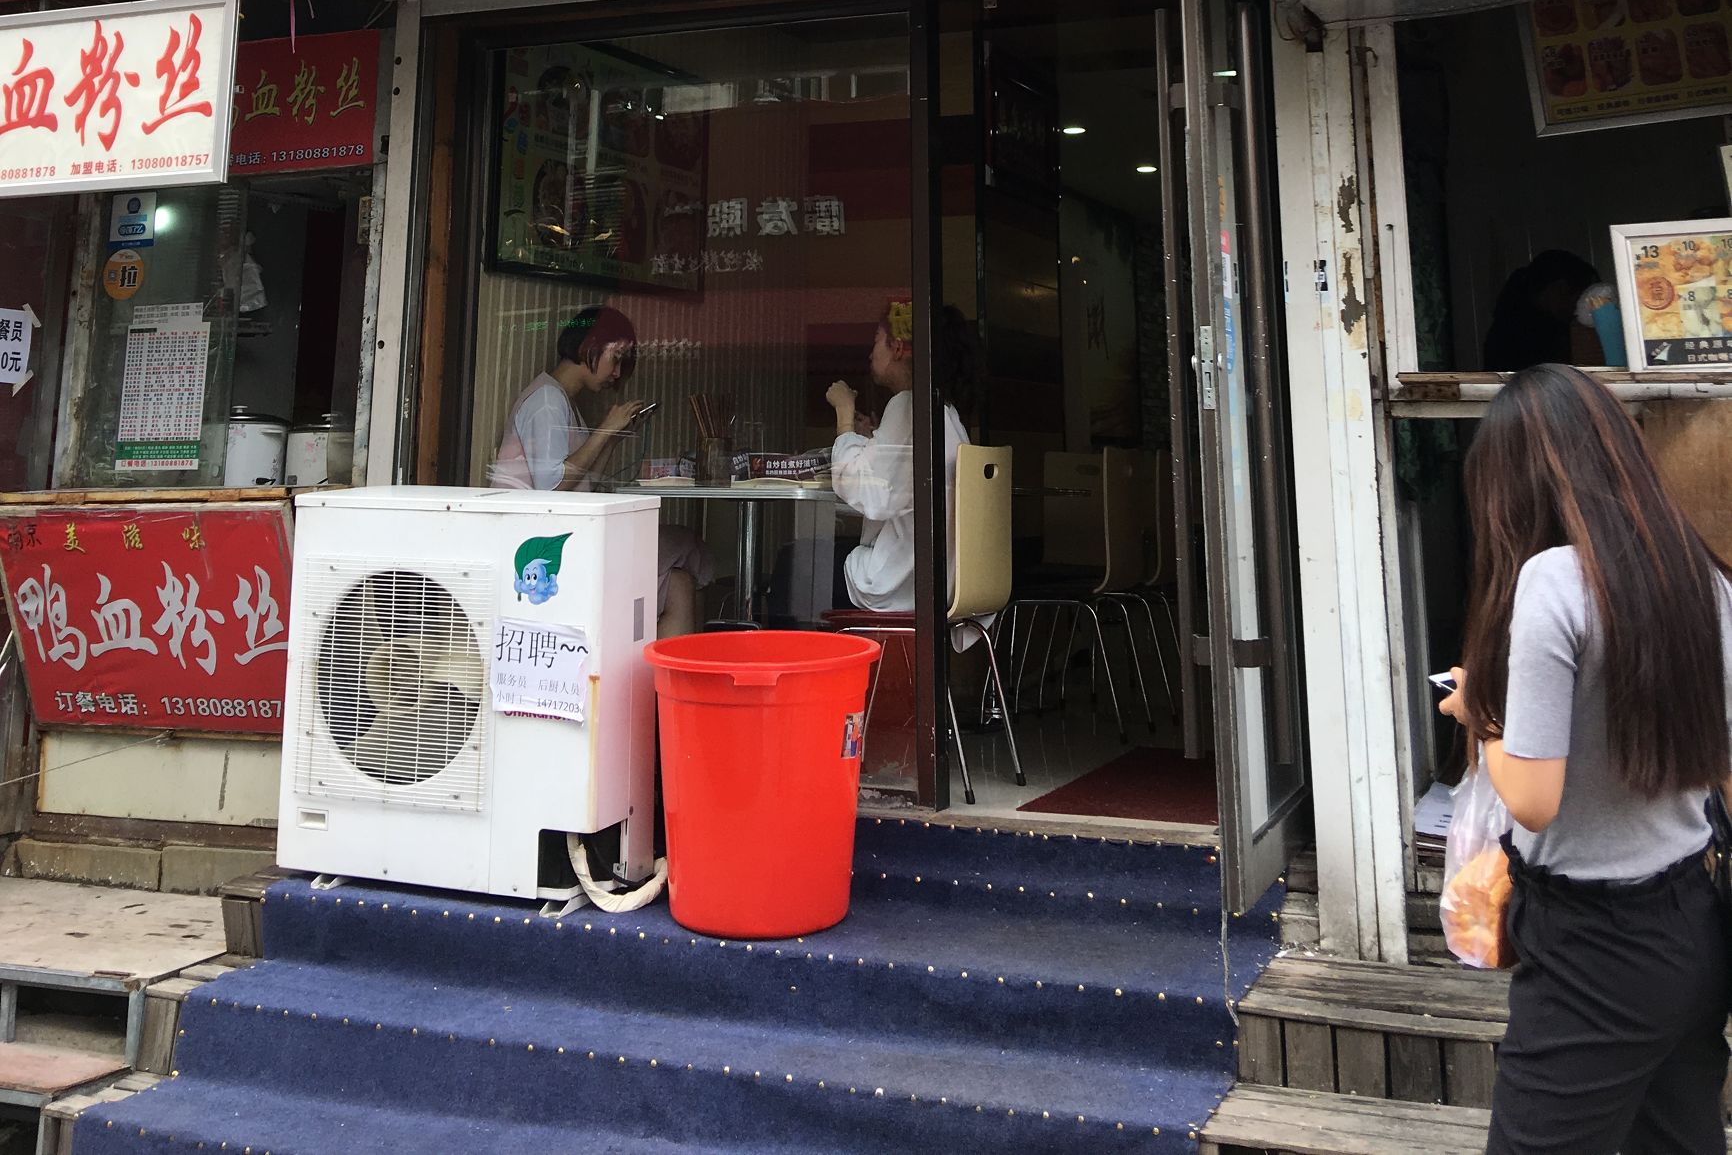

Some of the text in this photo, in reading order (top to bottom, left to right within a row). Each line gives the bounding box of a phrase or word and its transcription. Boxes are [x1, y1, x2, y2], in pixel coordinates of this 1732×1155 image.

[0, 13, 213, 152] 血粉丝
[231, 57, 366, 130] 血粉丝
[131, 153, 210, 170] 13080018757
[271, 144, 364, 162] 13180881878
[15, 561, 289, 675] 鸭血粉丝
[161, 696, 283, 718] 1318088187
